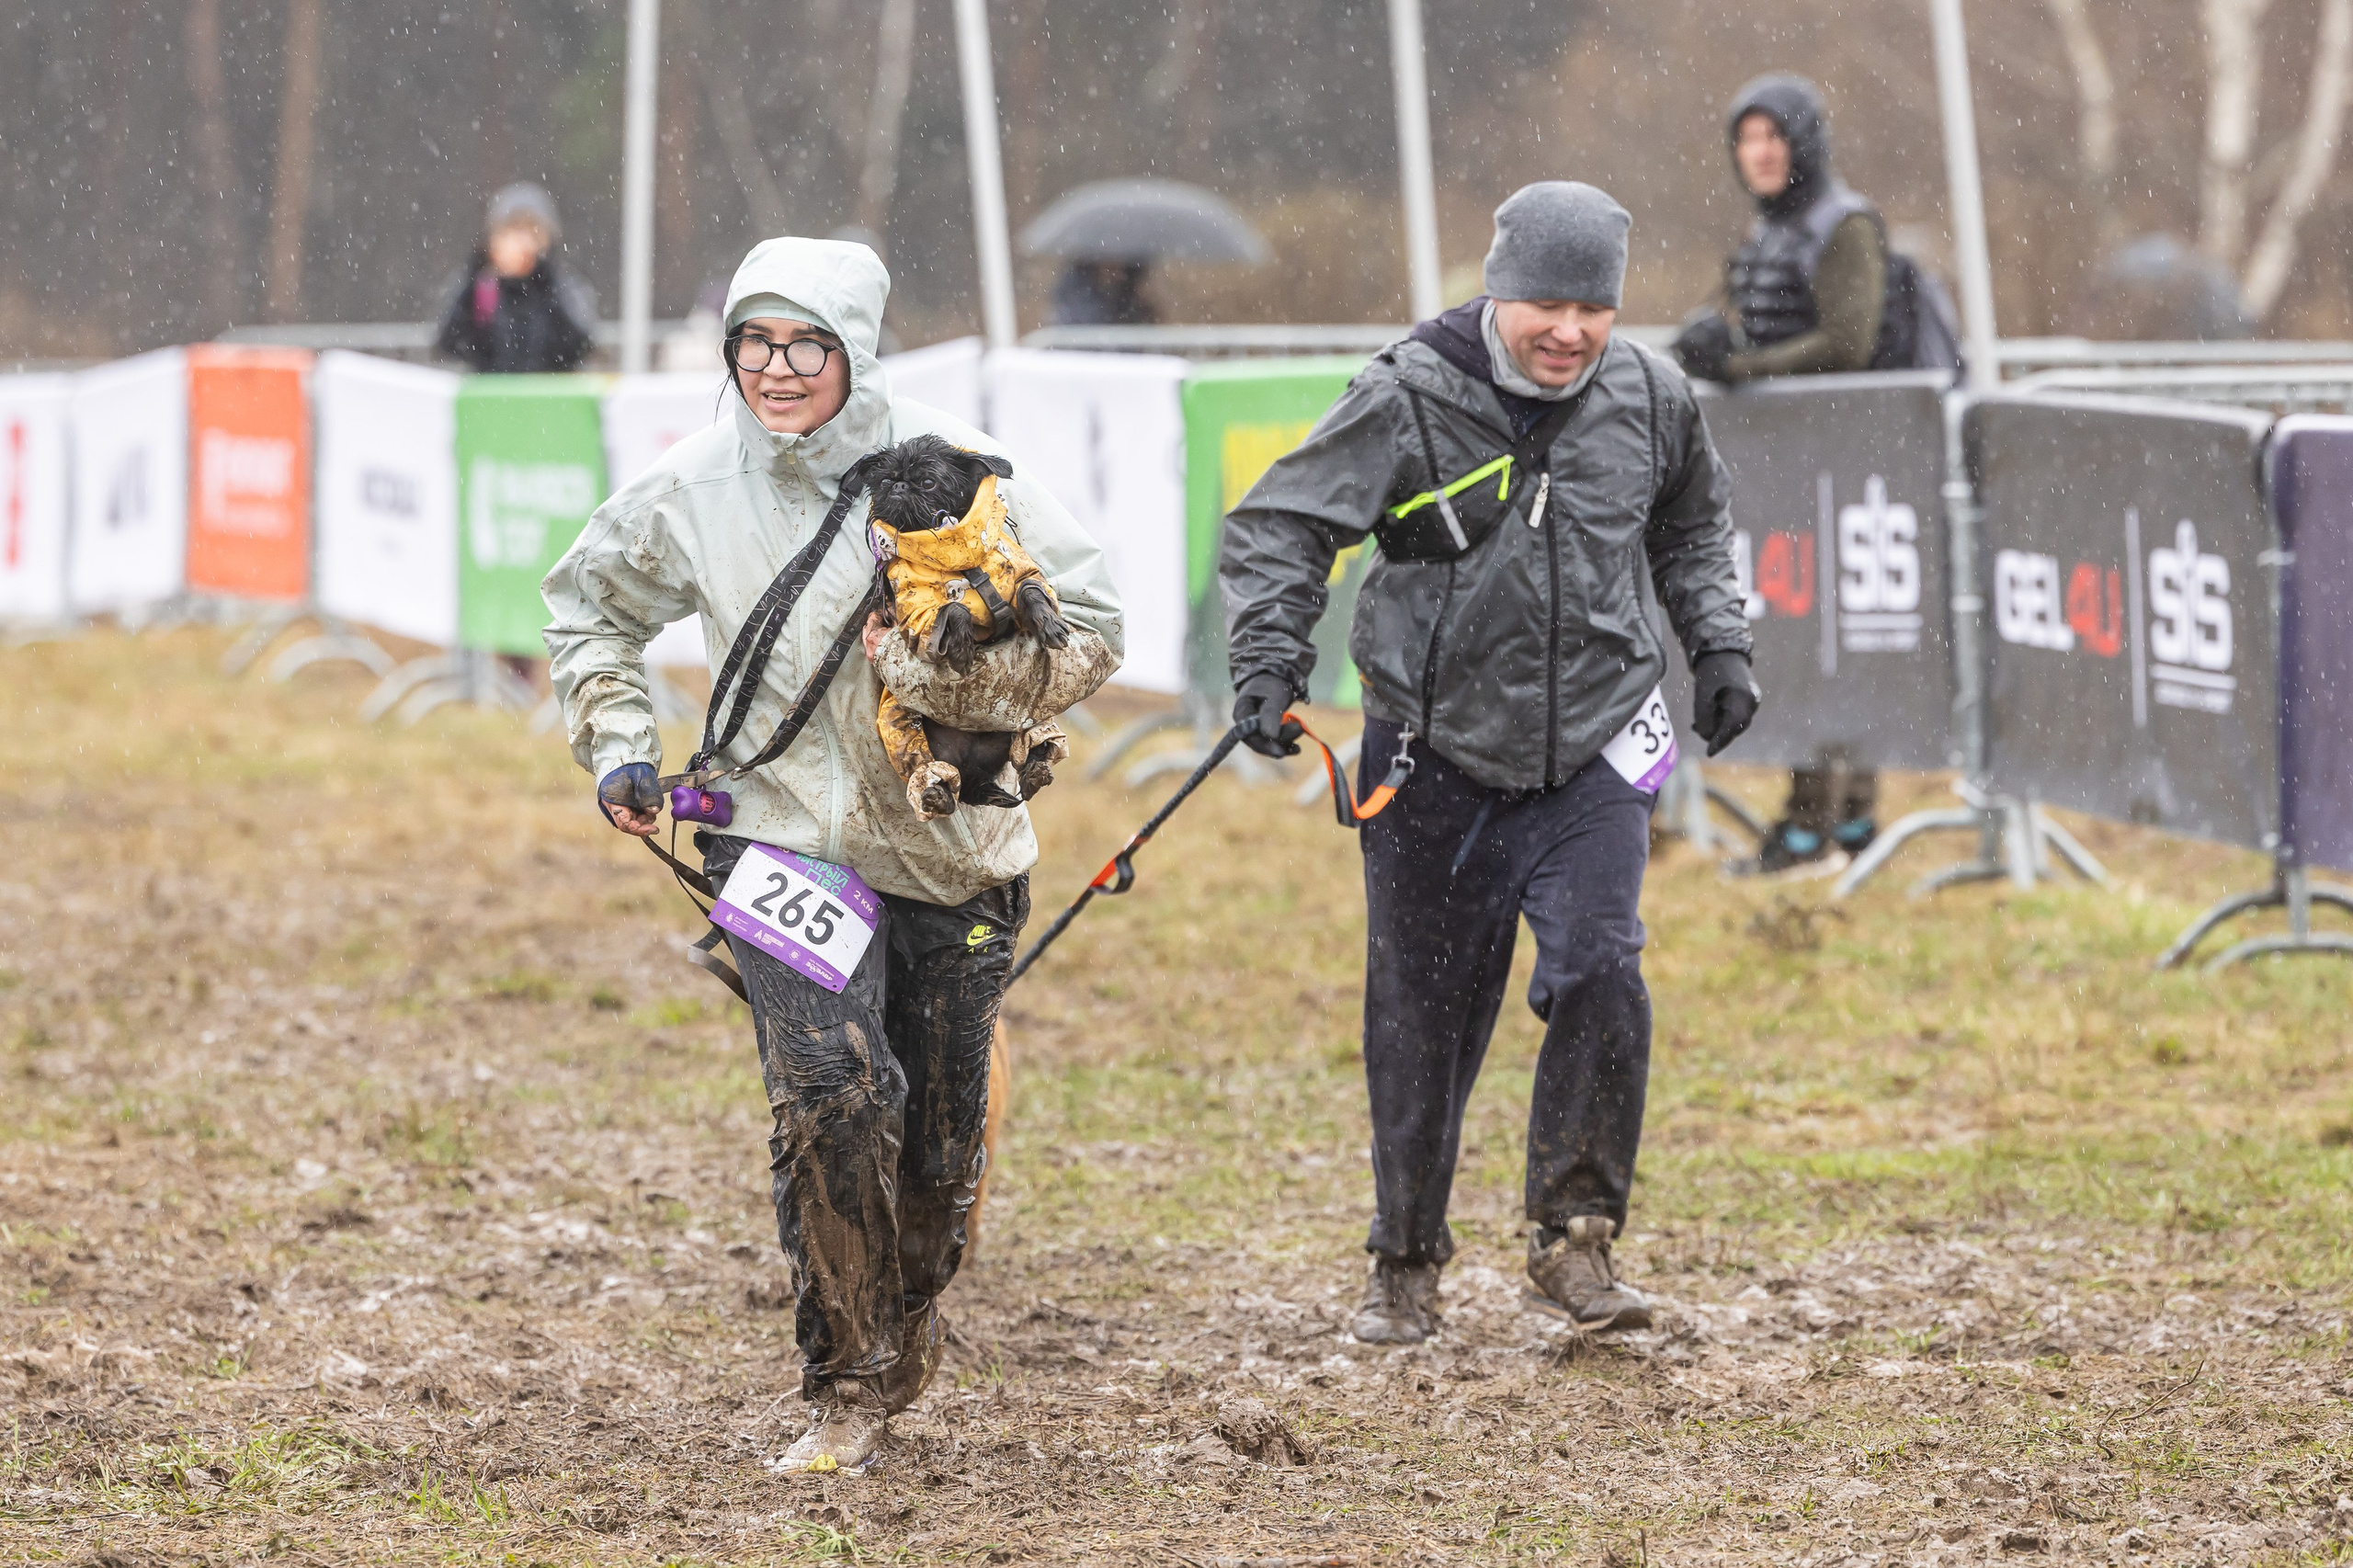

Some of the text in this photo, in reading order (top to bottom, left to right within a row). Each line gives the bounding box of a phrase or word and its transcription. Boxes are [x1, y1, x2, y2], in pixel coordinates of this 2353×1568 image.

[1735, 528, 1815, 619] L4U
[1994, 548, 2121, 658] GEL4U
[751, 872, 844, 946] 265
[853, 890, 861, 900] 2
